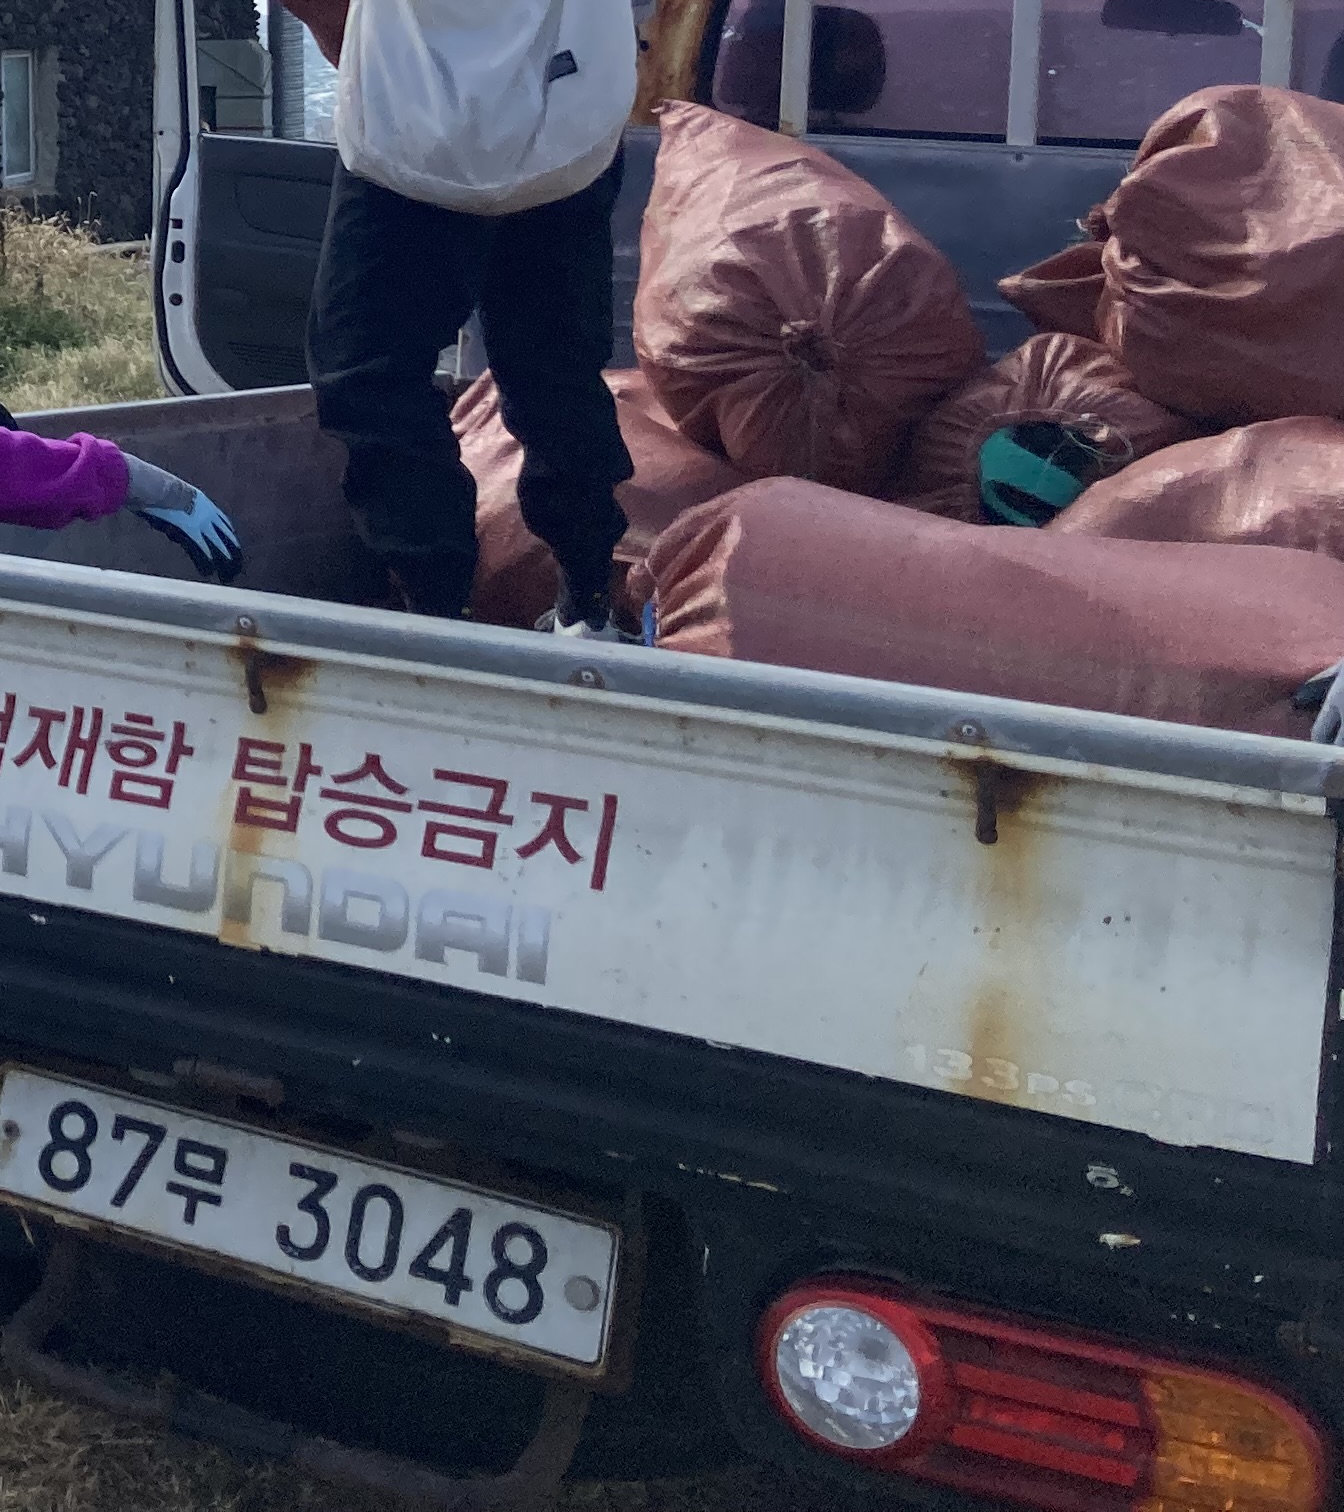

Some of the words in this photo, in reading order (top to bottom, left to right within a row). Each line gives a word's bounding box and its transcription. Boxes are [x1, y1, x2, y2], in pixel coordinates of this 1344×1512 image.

[230, 735, 619, 892] 탑승금지
[37, 1100, 229, 1226] 87무
[275, 1162, 549, 1326] 3048
